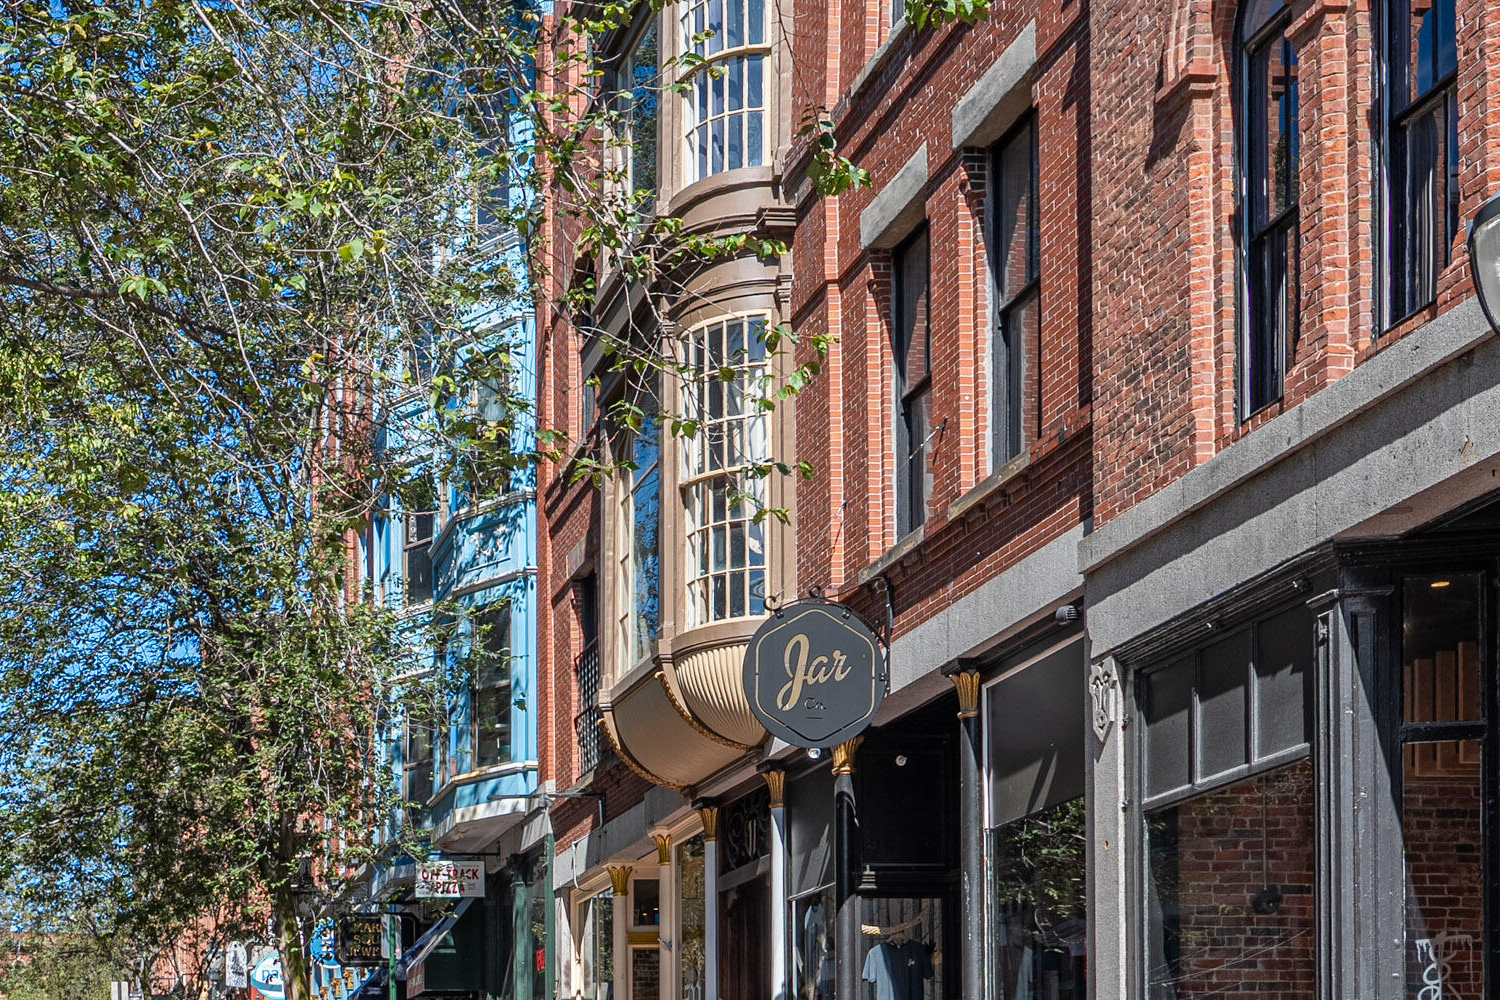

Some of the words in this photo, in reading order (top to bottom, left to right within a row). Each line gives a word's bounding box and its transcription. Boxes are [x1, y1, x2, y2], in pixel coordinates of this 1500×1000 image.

[777, 634, 852, 712] Jar
[804, 696, 827, 710] Co.
[422, 868, 479, 880] OFF-TRACK
[436, 881, 465, 894] PIZZA
[353, 934, 380, 946] SQU
